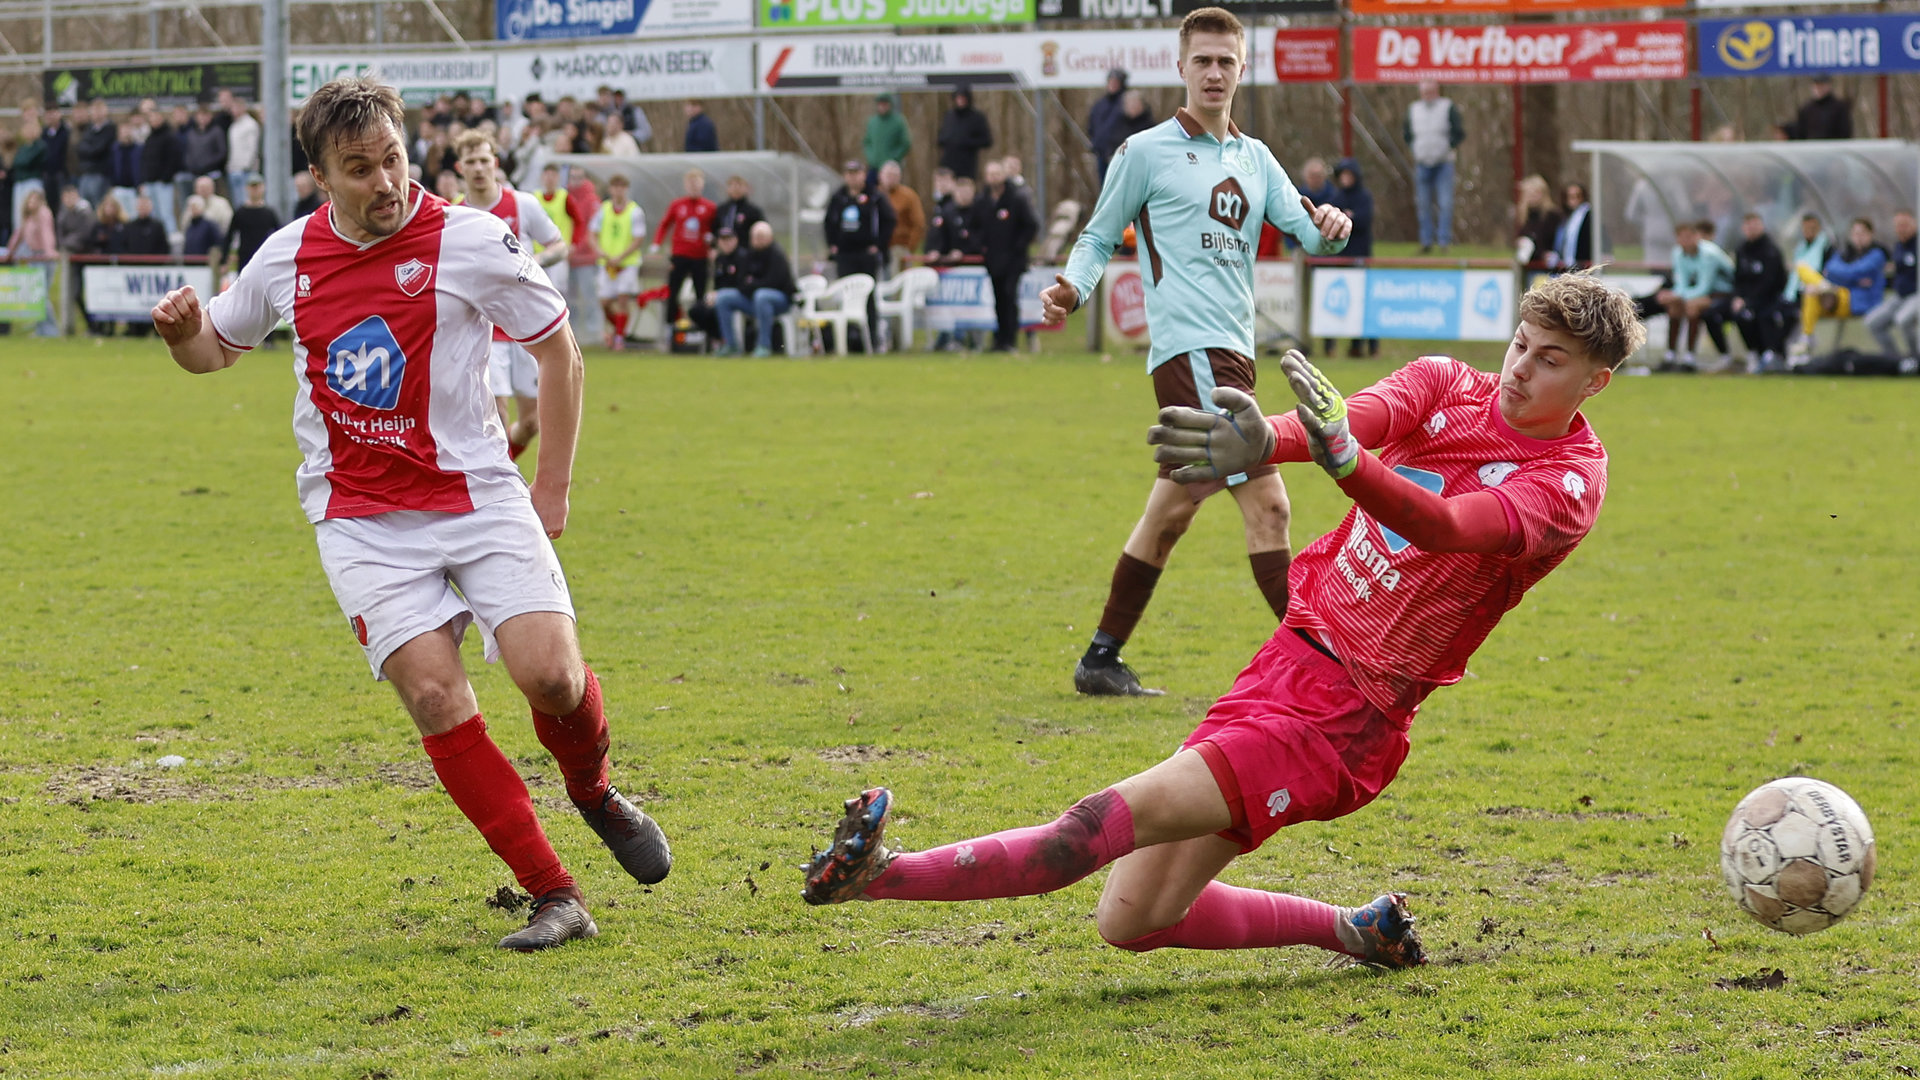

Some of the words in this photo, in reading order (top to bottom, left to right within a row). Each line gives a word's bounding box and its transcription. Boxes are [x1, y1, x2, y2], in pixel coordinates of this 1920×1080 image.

[533, 0, 563, 26] De
[566, 0, 634, 30] Singel
[797, 0, 886, 21] PLUS
[900, 0, 1025, 21] Jubbega
[813, 44, 867, 67] FIRMA
[872, 42, 946, 73] DIJKSMA
[1376, 28, 1421, 66] De
[1429, 25, 1570, 66] Verfboer
[1778, 18, 1880, 68] Primera
[554, 55, 623, 78] MARCO
[624, 52, 662, 76] VAN
[666, 50, 714, 74] BEEK
[1065, 49, 1128, 70] Gerald
[89, 67, 203, 97] Koenstruct
[291, 63, 369, 98] EN
[125, 273, 187, 294] WIMA
[1373, 280, 1417, 299] Albert
[370, 415, 415, 434] Heijn
